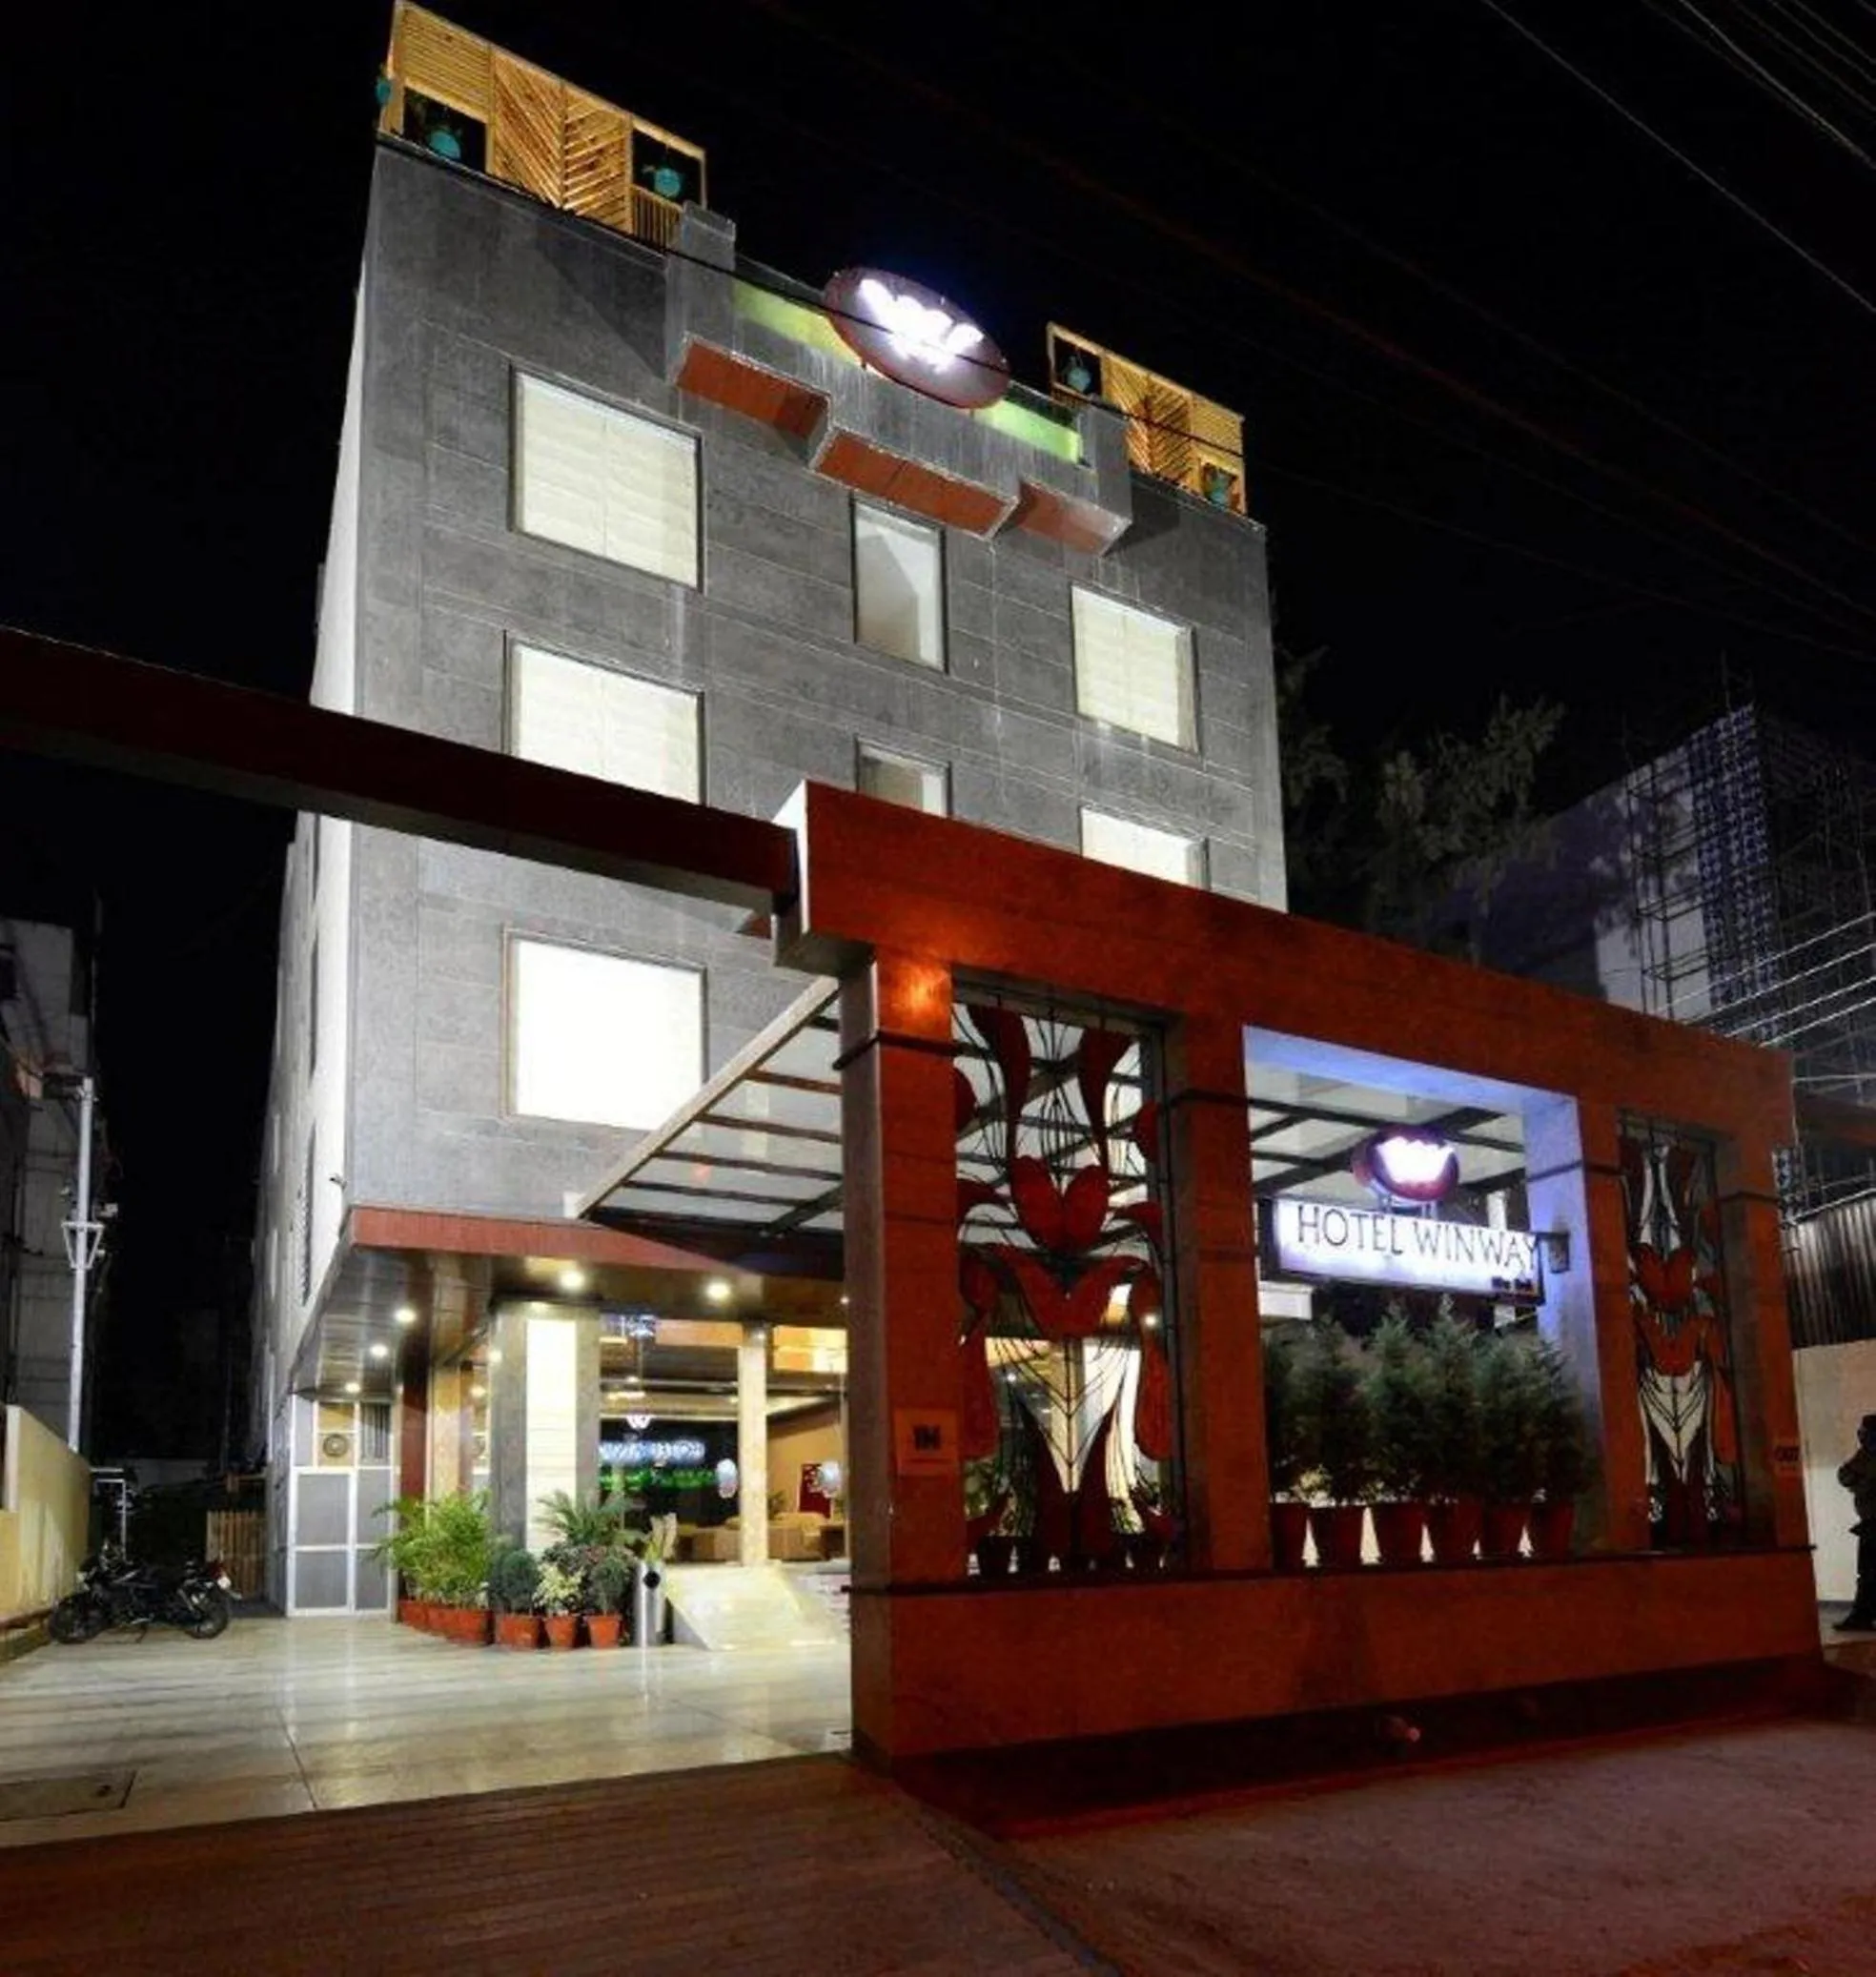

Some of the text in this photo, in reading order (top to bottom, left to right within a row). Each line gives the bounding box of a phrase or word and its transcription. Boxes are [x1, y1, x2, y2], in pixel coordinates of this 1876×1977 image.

[1297, 1205, 1539, 1272] HOTEL WINWAY
[912, 1424, 942, 1451] IN
